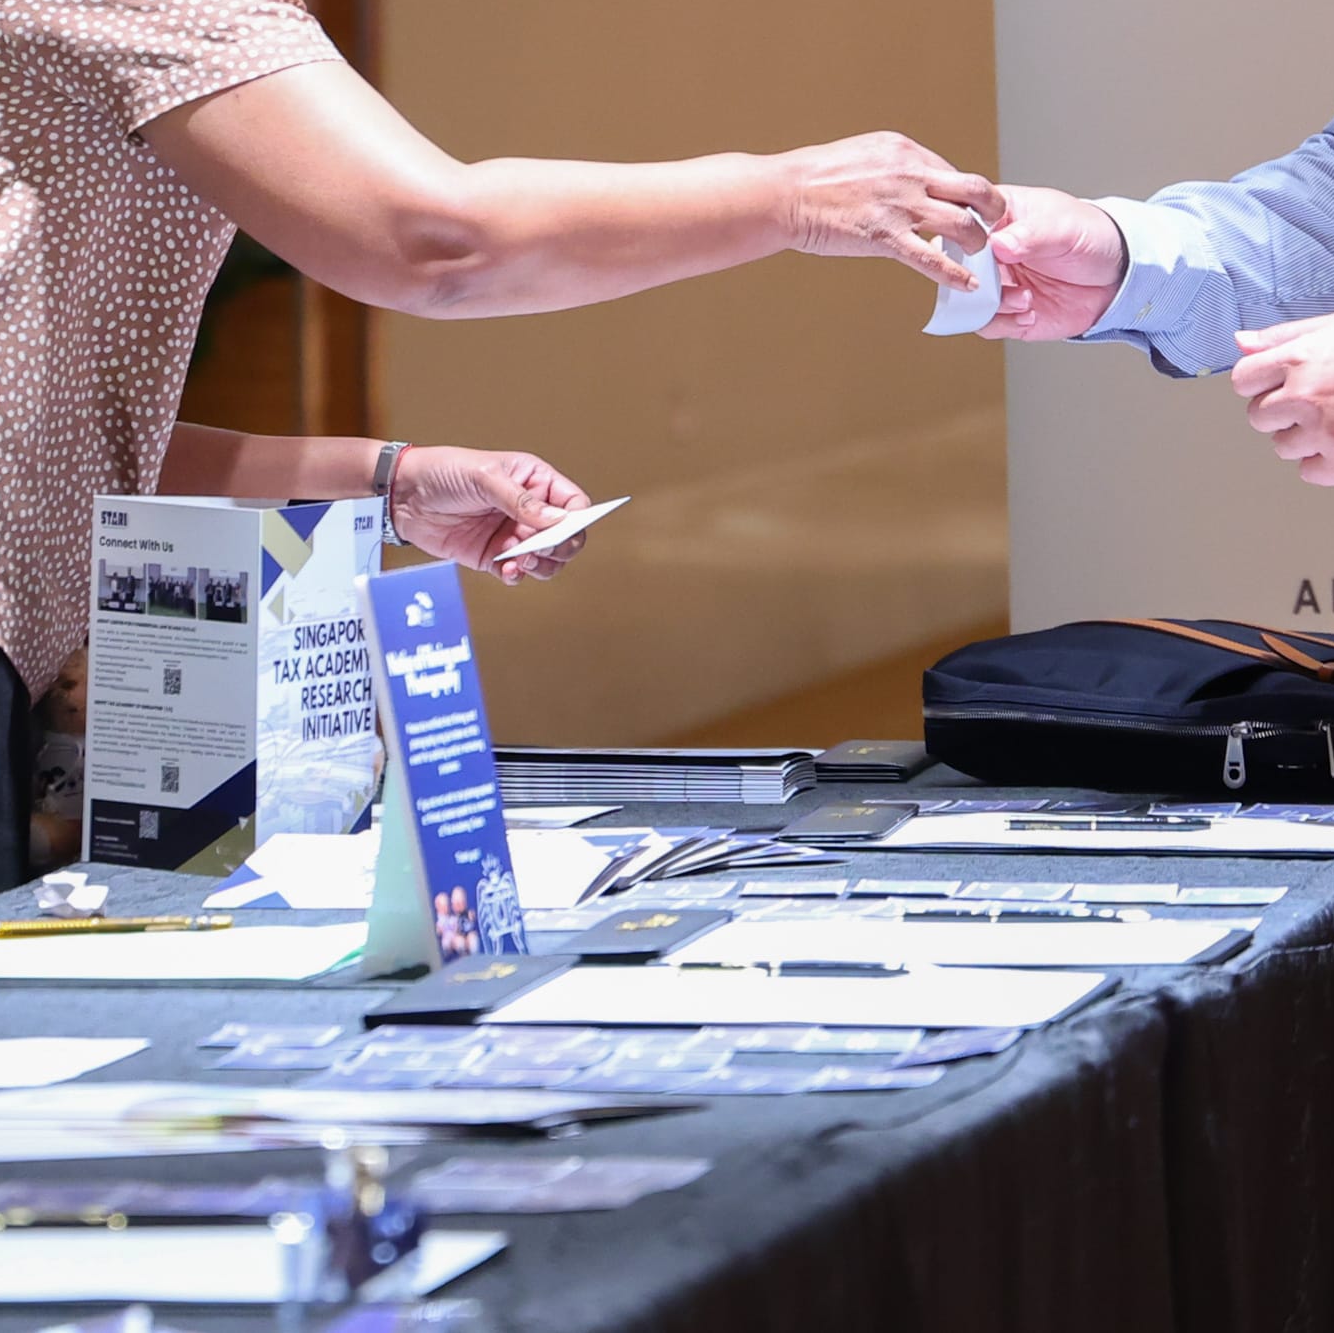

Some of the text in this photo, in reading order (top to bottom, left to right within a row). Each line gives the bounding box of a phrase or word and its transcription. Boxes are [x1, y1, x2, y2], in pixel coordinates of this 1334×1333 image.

[99, 535, 174, 553] Connect With Us
[1293, 579, 1321, 616] A
[293, 617, 366, 652] SINGAPOR
[273, 647, 370, 686] TAX ACADEMY
[301, 676, 373, 712] RESEARCH
[302, 706, 372, 743] INITIATIVE
